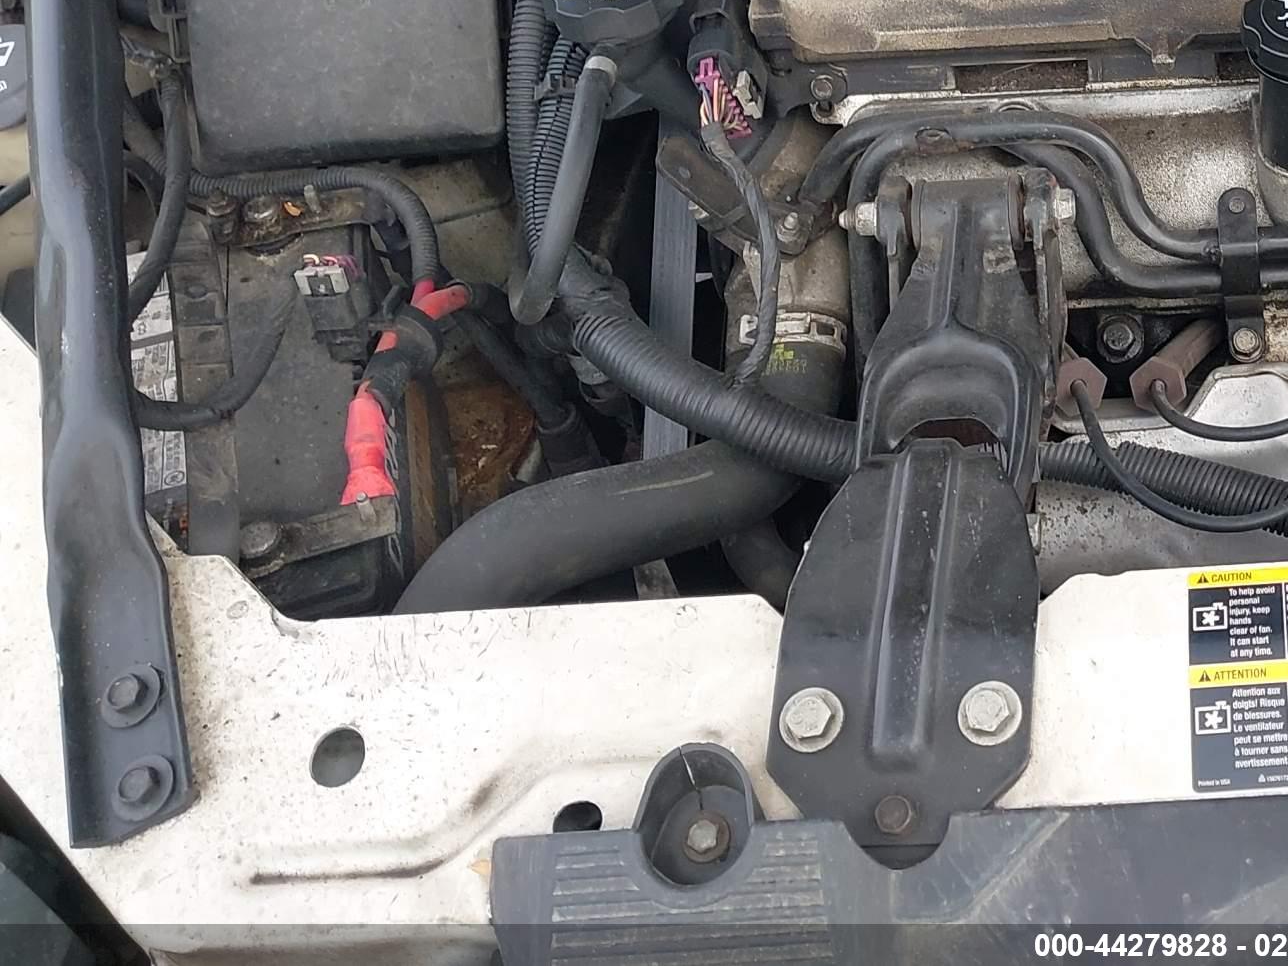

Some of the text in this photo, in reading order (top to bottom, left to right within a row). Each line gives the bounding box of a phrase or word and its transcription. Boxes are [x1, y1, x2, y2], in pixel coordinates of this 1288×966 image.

[1211, 572, 1251, 582] CAUTION
[1238, 587, 1254, 596] help
[1229, 597, 1259, 606] personal
[1252, 605, 1270, 614] keep
[1229, 616, 1251, 624] hands
[1229, 625, 1257, 635] clear of
[1252, 635, 1268, 644] start
[1230, 648, 1252, 658] at any
[1214, 668, 1266, 680] ATTENTION
[1232, 687, 1265, 697] Attention
[1259, 696, 1284, 708] Risque
[1232, 712, 1242, 720] de
[1233, 724, 1242, 732] Le
[1234, 735, 1250, 745] peut
[1270, 745, 1288, 753] sans
